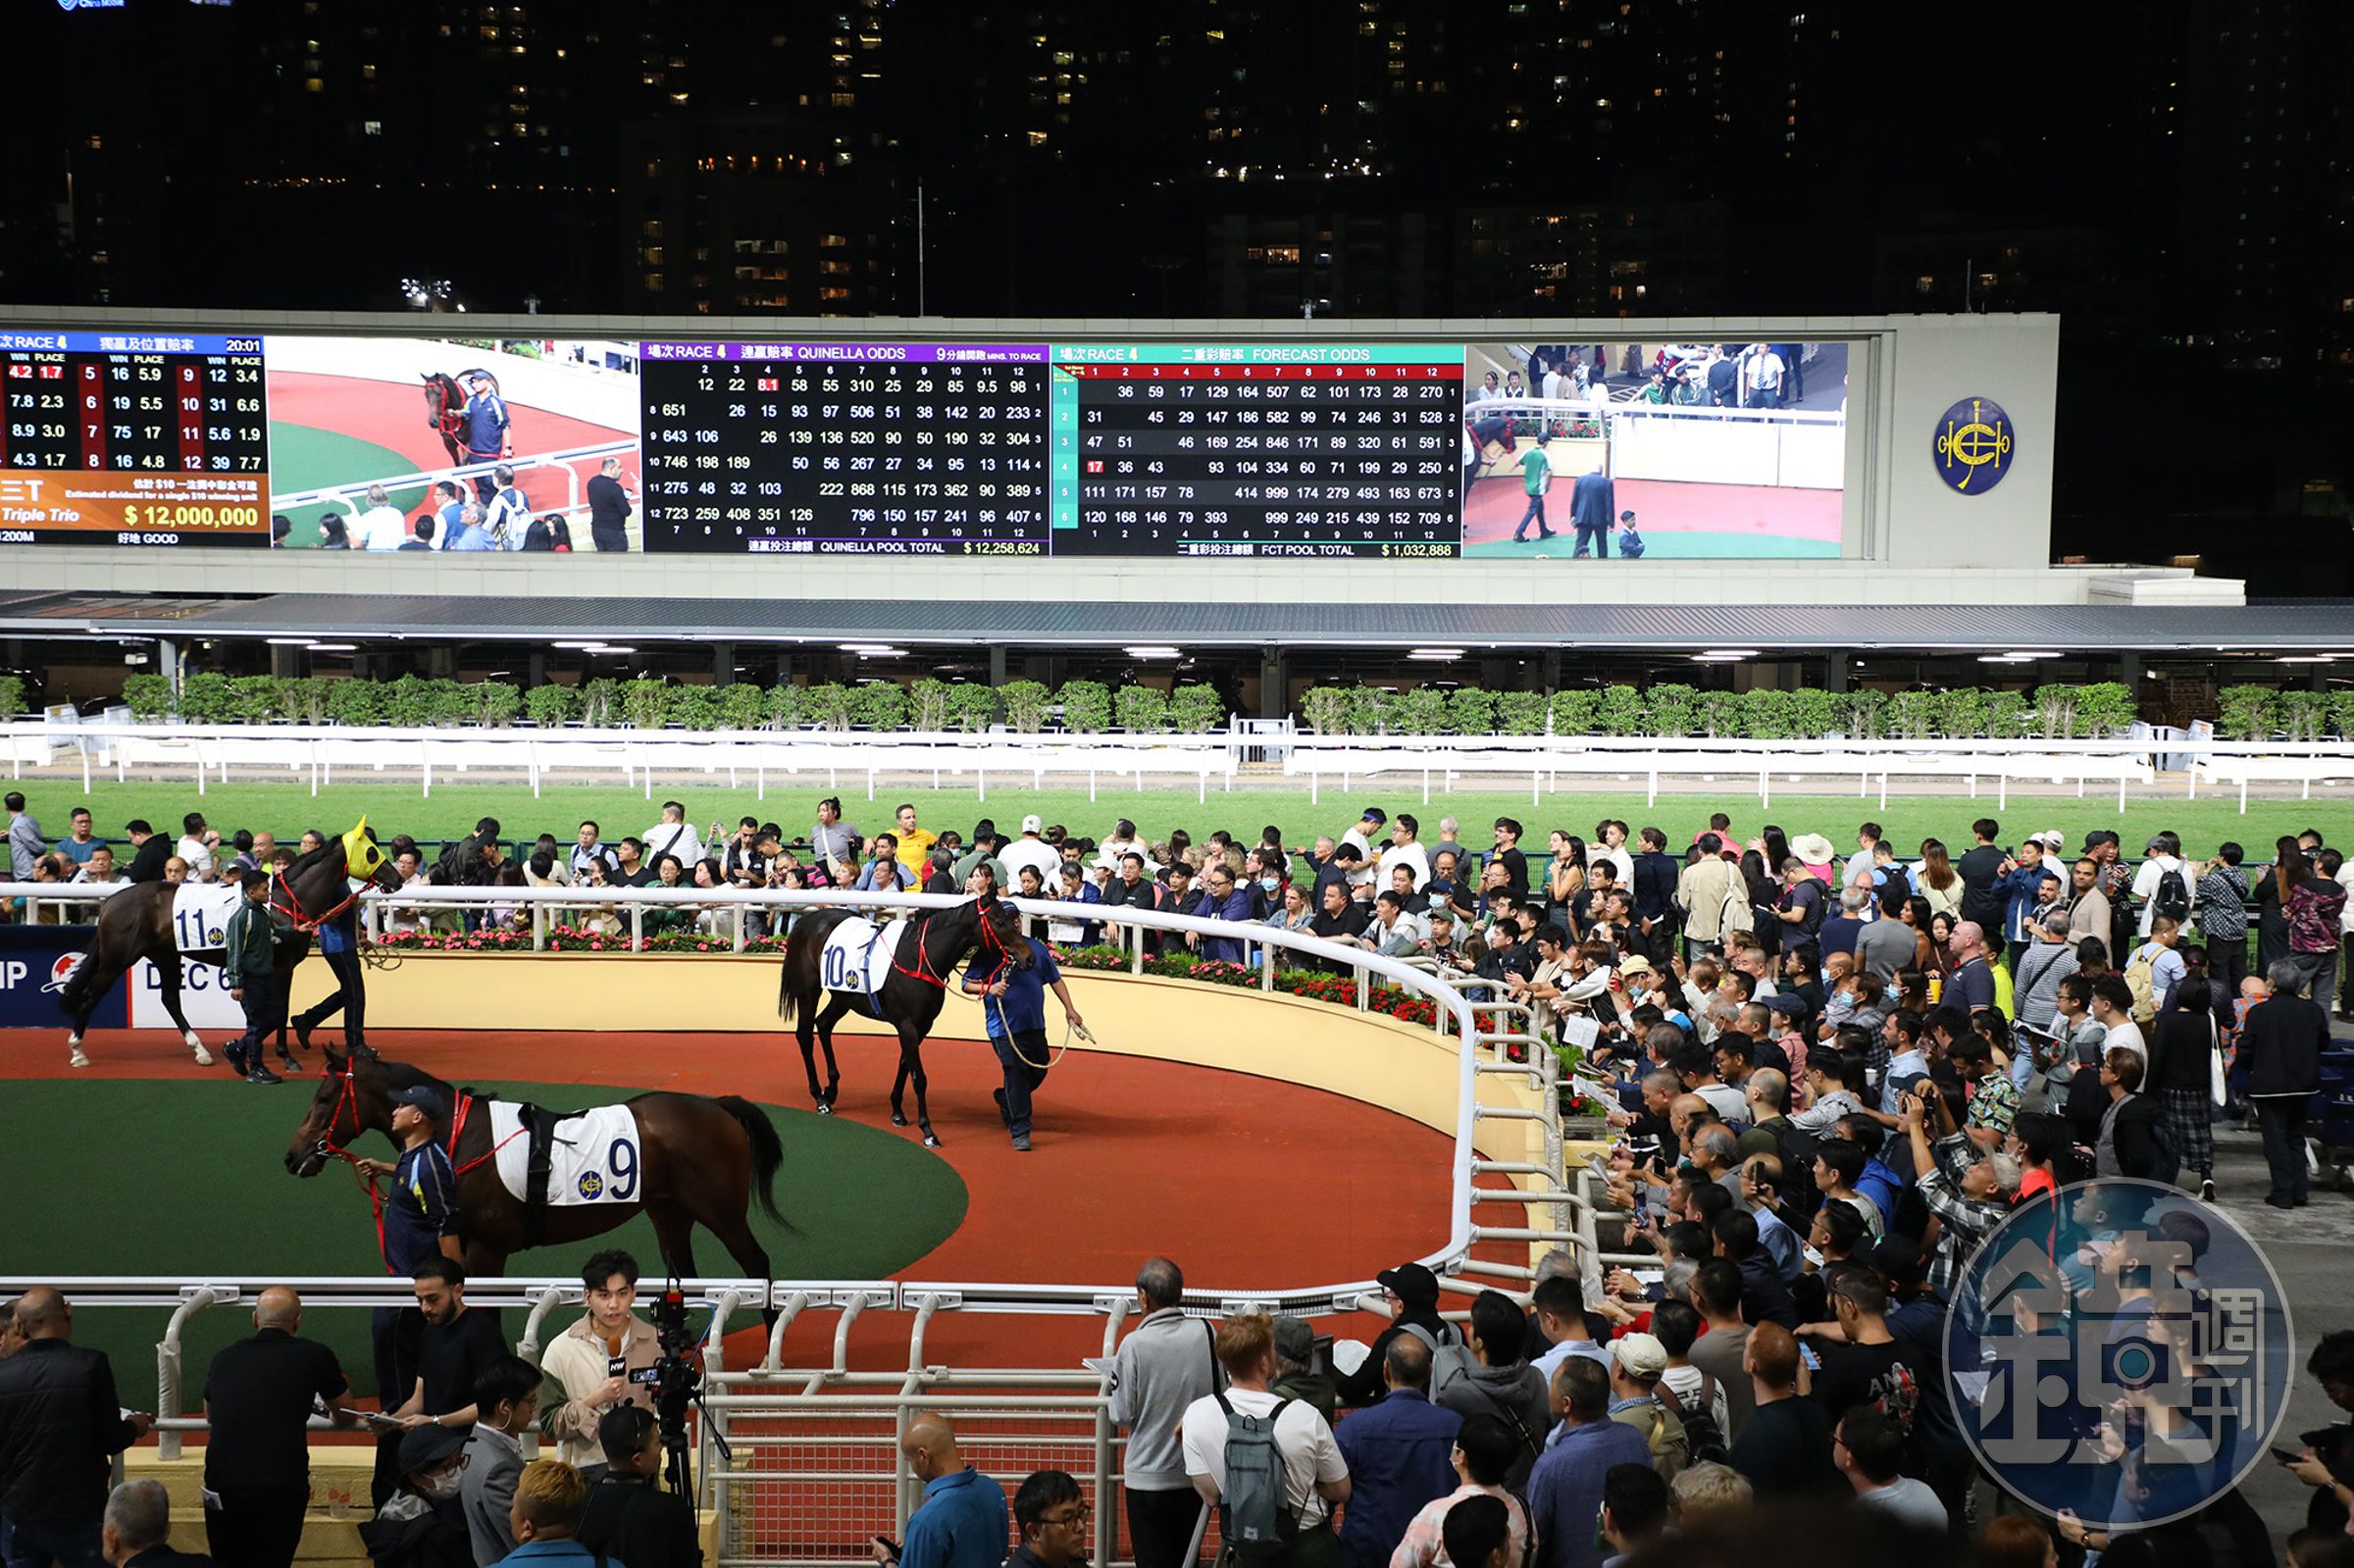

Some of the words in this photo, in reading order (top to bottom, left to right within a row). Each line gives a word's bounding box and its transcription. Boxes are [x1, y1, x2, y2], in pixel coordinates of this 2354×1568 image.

[15, 337, 54, 348] RACE
[57, 335, 67, 349] 4
[226, 339, 260, 352] 20:01
[35, 354, 66, 362] PLACE
[134, 355, 165, 364] PLACE
[676, 346, 712, 358] RACE
[717, 345, 726, 358] 4
[798, 347, 865, 359] QUINELLA
[867, 348, 906, 360] ODDS
[1088, 349, 1124, 361] RACE
[1129, 347, 1138, 361] 4
[1181, 349, 1244, 361] 二重彩賠率
[1253, 349, 1327, 361] FORECAST
[1330, 349, 1371, 361] ODDS
[231, 357, 261, 366] PLACE
[8, 365, 33, 378] 4.2
[41, 365, 62, 379] 1.7
[85, 366, 96, 380] 5
[111, 367, 129, 380] 16
[139, 367, 161, 381] 5.9
[183, 368, 194, 382] 9
[209, 368, 227, 382] 12
[236, 369, 258, 383] 3.4
[698, 378, 714, 391] 12
[728, 378, 745, 391] 22
[758, 378, 779, 392] 8.1
[791, 379, 808, 392] 58
[822, 379, 839, 392] 55
[850, 379, 874, 392] 310
[885, 379, 902, 393] 25
[917, 380, 933, 393] 29
[947, 380, 965, 393] 85
[976, 380, 998, 393] 9.5
[1010, 380, 1026, 394] 98
[1118, 385, 1133, 398] 36
[1148, 386, 1164, 398] 59
[1179, 386, 1194, 398] 17
[1206, 386, 1228, 398] 129
[1236, 386, 1259, 398] 164
[1266, 386, 1289, 399] 507
[1300, 386, 1317, 399] 62
[1329, 386, 1349, 399] 101
[1359, 386, 1382, 399] 173
[1392, 386, 1408, 399] 28
[1420, 386, 1443, 399] 270
[10, 395, 34, 407] 7.8
[41, 395, 64, 408] 2.3
[86, 396, 97, 408] 6
[112, 396, 130, 409] 19
[140, 397, 162, 410] 5.5
[182, 398, 200, 410] 10
[209, 398, 226, 411] 31
[237, 399, 259, 411] 6.6
[12, 423, 35, 437] 8.9
[43, 424, 65, 438] 3.0
[88, 425, 98, 438] 7
[113, 425, 132, 439] 75
[144, 426, 161, 439] 17
[183, 427, 199, 440] 11
[208, 427, 231, 441] 5.6
[239, 428, 260, 441] 1.9
[650, 431, 658, 441] 9
[663, 429, 688, 443] 643
[695, 430, 718, 443] 106
[761, 430, 777, 444] 26
[789, 431, 813, 444] 139
[819, 431, 843, 444] 136
[850, 431, 874, 444] 520
[885, 431, 902, 445] 90
[917, 432, 933, 445] 50
[945, 432, 969, 445] 190
[979, 432, 995, 445] 32
[1006, 432, 1030, 446] 304
[1035, 435, 1041, 444] 3
[1087, 436, 1103, 448] 47
[1118, 436, 1131, 448] 51
[1177, 436, 1194, 449] 46
[1206, 436, 1228, 449] 169
[1235, 436, 1259, 449] 254
[1266, 436, 1289, 449] 846
[1297, 437, 1318, 449] 171
[1331, 437, 1346, 449] 89
[1357, 437, 1381, 449] 320
[1391, 437, 1406, 449] 61
[1419, 437, 1440, 449] 591
[13, 453, 37, 466] 4.3
[45, 454, 66, 466] 1.7
[89, 454, 100, 467] 8
[115, 455, 133, 467] 16
[142, 455, 165, 468] 4.8
[184, 455, 202, 469] 12
[211, 455, 230, 469] 39
[239, 456, 261, 469] 7.7
[144, 491, 157, 500] for
[2, 507, 46, 524] Triple
[49, 508, 80, 522] Trio
[125, 505, 139, 526] $
[145, 506, 258, 528] 12,000,000
[143, 533, 179, 544] GOOD
[820, 542, 874, 552] QUINELLA
[877, 543, 907, 553] POOL
[910, 543, 945, 553] TOTAL
[964, 542, 972, 554] $
[975, 543, 1040, 554] 12,258,624
[1261, 545, 1283, 555] FCT
[1286, 545, 1316, 555] POOL
[1319, 545, 1354, 555] TOTAL
[1382, 544, 1390, 556] $
[1393, 545, 1452, 557] 1,032,888
[176, 908, 206, 948] 11
[824, 944, 845, 987] 10
[147, 962, 208, 991] DC
[608, 1138, 638, 1200] 9
